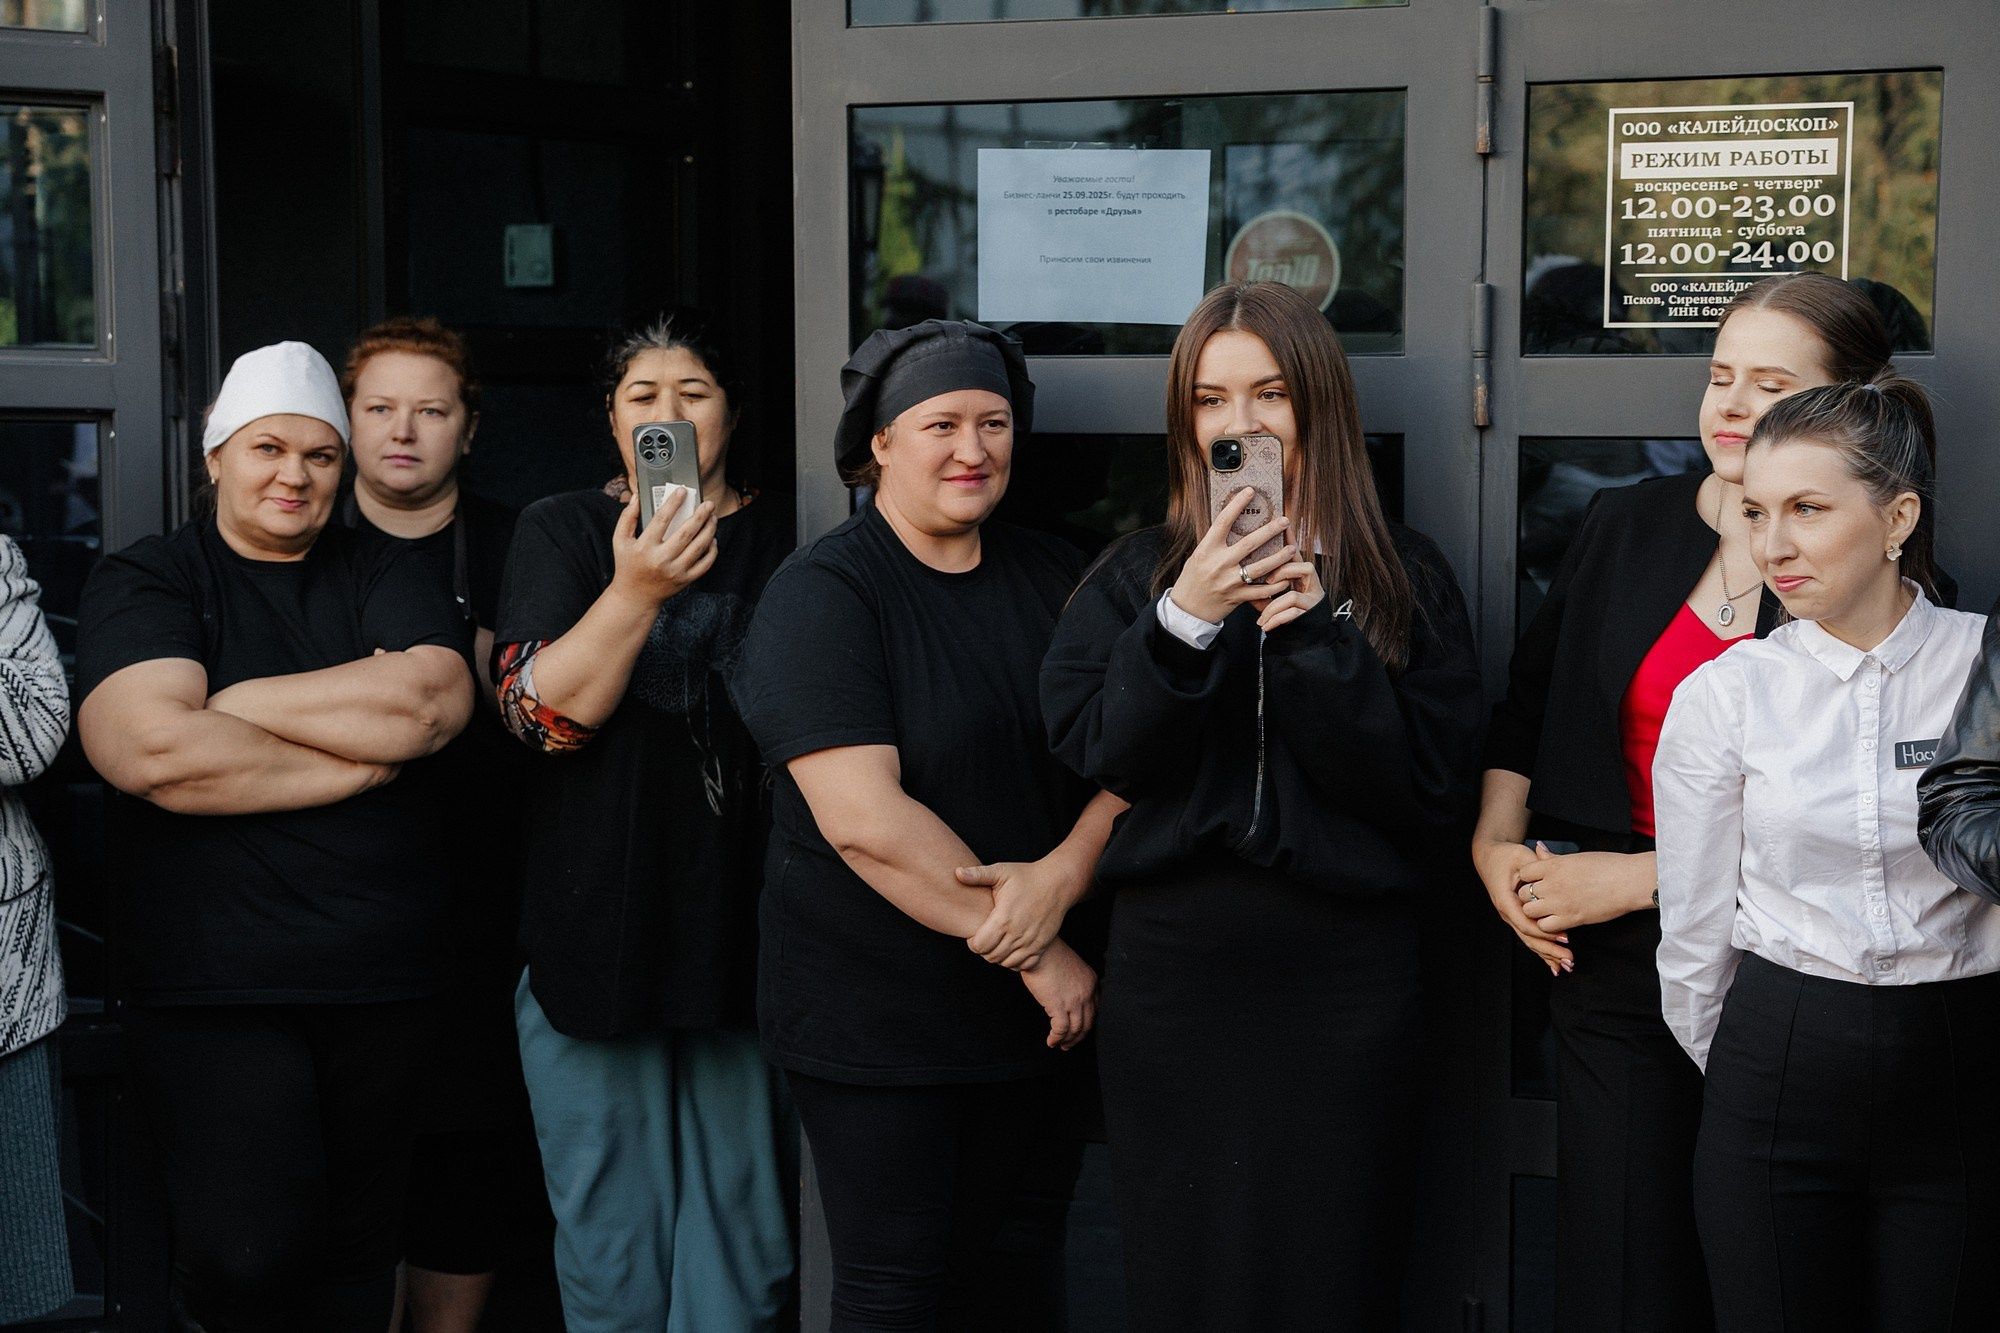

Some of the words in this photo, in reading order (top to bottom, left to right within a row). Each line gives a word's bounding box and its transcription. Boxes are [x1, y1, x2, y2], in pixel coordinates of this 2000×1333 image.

[1621, 121, 1661, 136] ООО
[1667, 115, 1839, 136] «КАЛЕЙДОСКОП»
[1630, 151, 1721, 169] РЕЖИМ
[1730, 149, 1829, 167] РАБОТЫ
[1053, 174, 1103, 184] Уважаемые
[1105, 174, 1136, 184] гости!
[1634, 181, 1738, 195] воскресенье
[1753, 179, 1823, 193] четверг
[1003, 190, 1061, 200] Бизнес-ланчи
[1063, 190, 1114, 200] 25.09.2025г.
[1116, 191, 1139, 202] будут
[1141, 191, 1186, 202] проходить
[1054, 207, 1099, 217] рестобаре
[1101, 207, 1142, 217] «Друзья»
[1620, 194, 1837, 223] 12.00-23.00
[1647, 226, 1722, 239] пятница
[1737, 222, 1806, 240] суббота
[1039, 255, 1083, 264] Приносим
[1085, 256, 1105, 264] свои
[1107, 256, 1152, 264] извинения
[1619, 240, 1836, 269] 12.00-24.00
[1650, 282, 1678, 293] ООО
[1681, 279, 1753, 294] «КАЛЕЙДО
[1623, 295, 1665, 307] Псков,
[1668, 306, 1699, 317] ИНН
